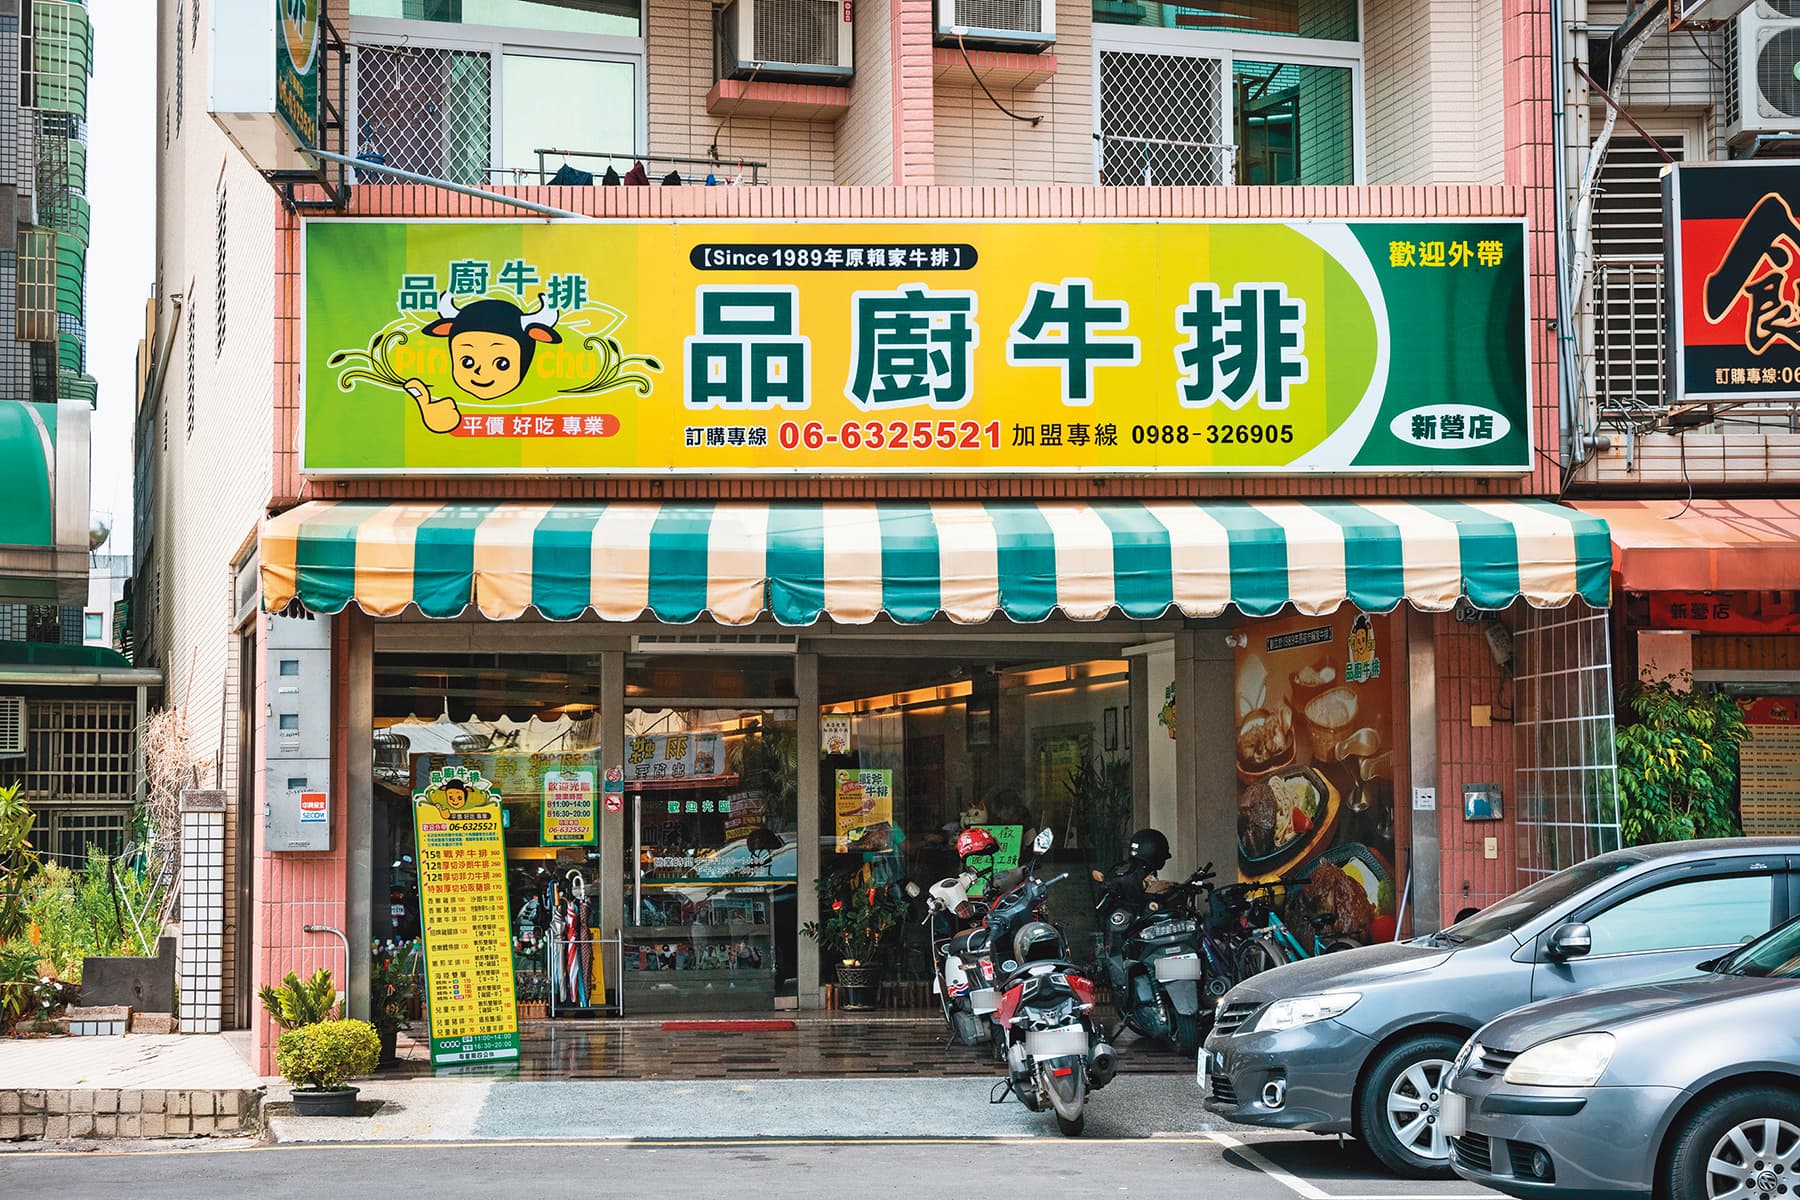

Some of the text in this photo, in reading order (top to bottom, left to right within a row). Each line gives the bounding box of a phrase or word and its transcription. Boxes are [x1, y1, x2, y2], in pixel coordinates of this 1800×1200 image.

[1389, 241, 1504, 267] 歡迎外帶
[401, 260, 587, 311] 品廚牛排
[689, 283, 1303, 406] 品廚牛排
[395, 340, 595, 378] pin chu
[463, 416, 604, 435] 平價 好吃 專業
[685, 421, 1293, 449] 訂購專線 06-6325521 加盟專線 0988-326905
[1411, 414, 1493, 440] 新營店
[1670, 602, 1731, 621] 新營店
[548, 782, 590, 792] 歡迎光臨
[449, 822, 497, 831] 06-6325521
